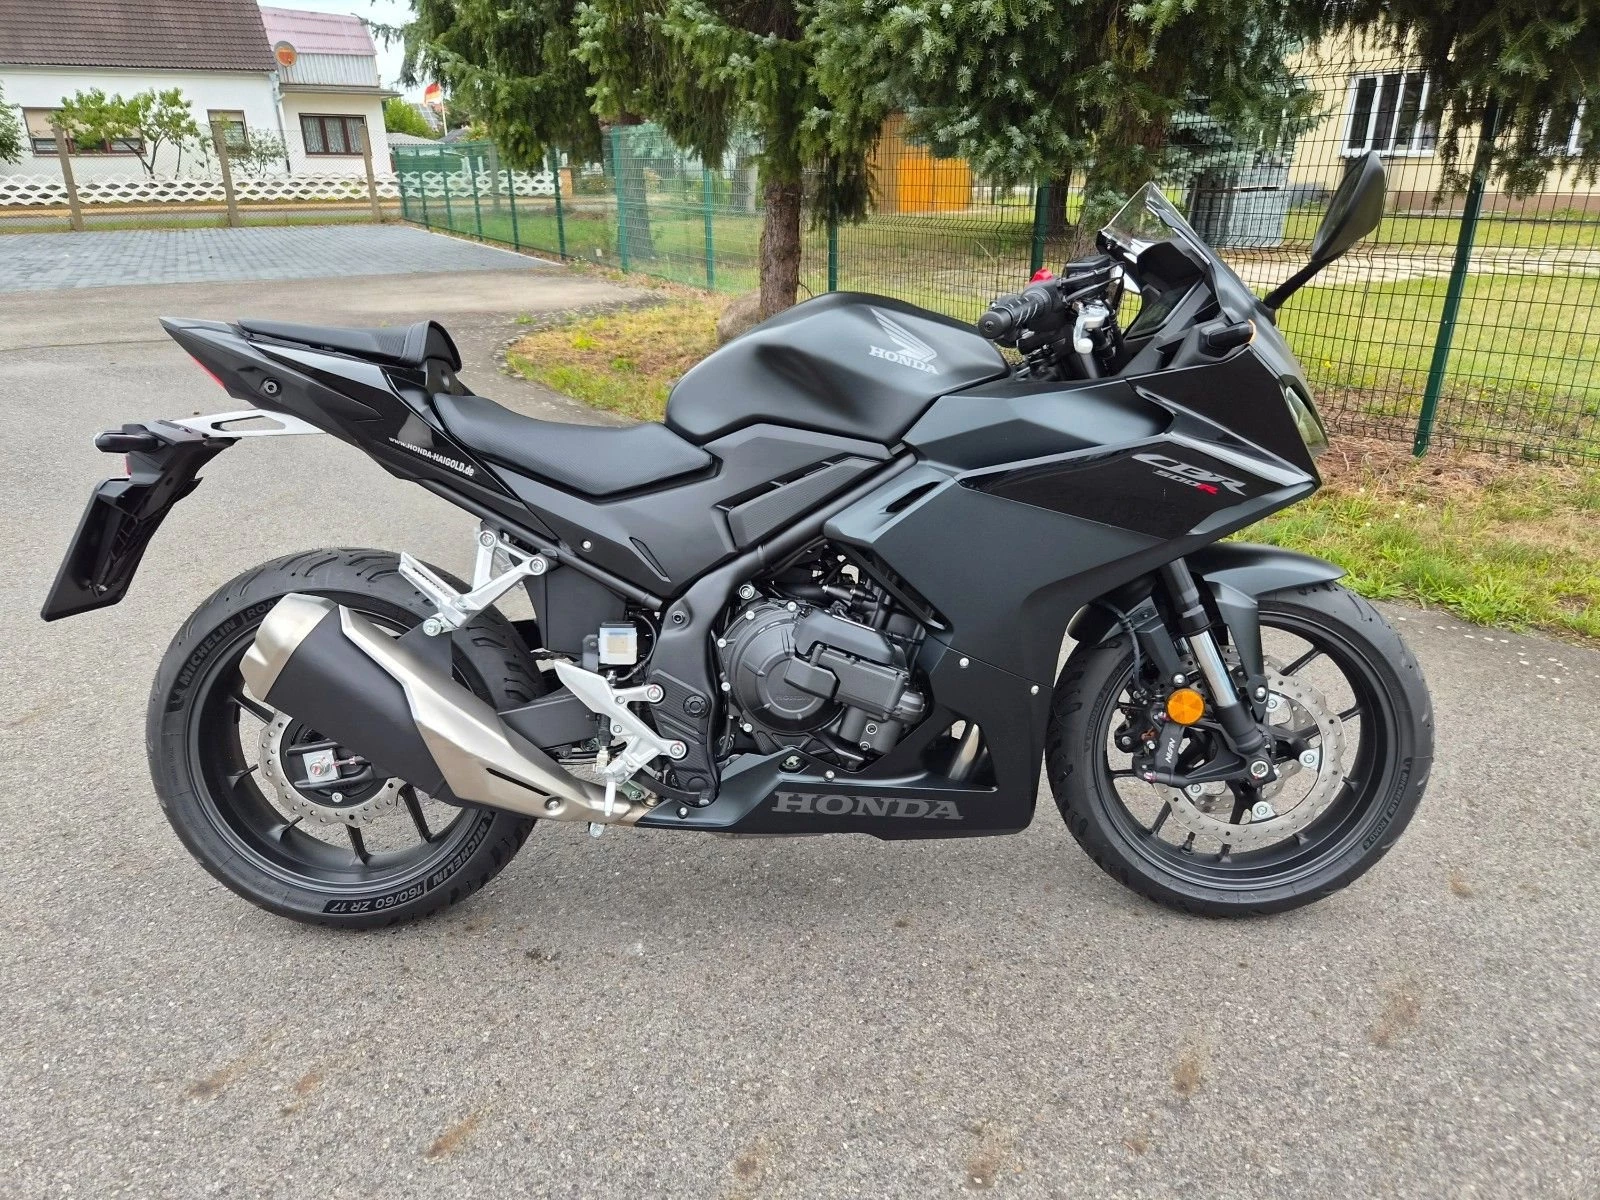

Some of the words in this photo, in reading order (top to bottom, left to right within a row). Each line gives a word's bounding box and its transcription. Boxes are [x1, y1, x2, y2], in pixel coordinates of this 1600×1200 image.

[868, 345, 940, 375] HONDA
[388, 437, 475, 477] www.HONDA-HAIGOLD.de
[1131, 453, 1247, 496] CBR
[180, 619, 236, 686] MICHELIN
[246, 600, 277, 618] ROA
[771, 791, 964, 820] HONDA
[432, 821, 488, 886] MICHELIN
[330, 902, 347, 912] 17
[350, 900, 371, 912] ZR
[375, 885, 424, 909] 160/60
